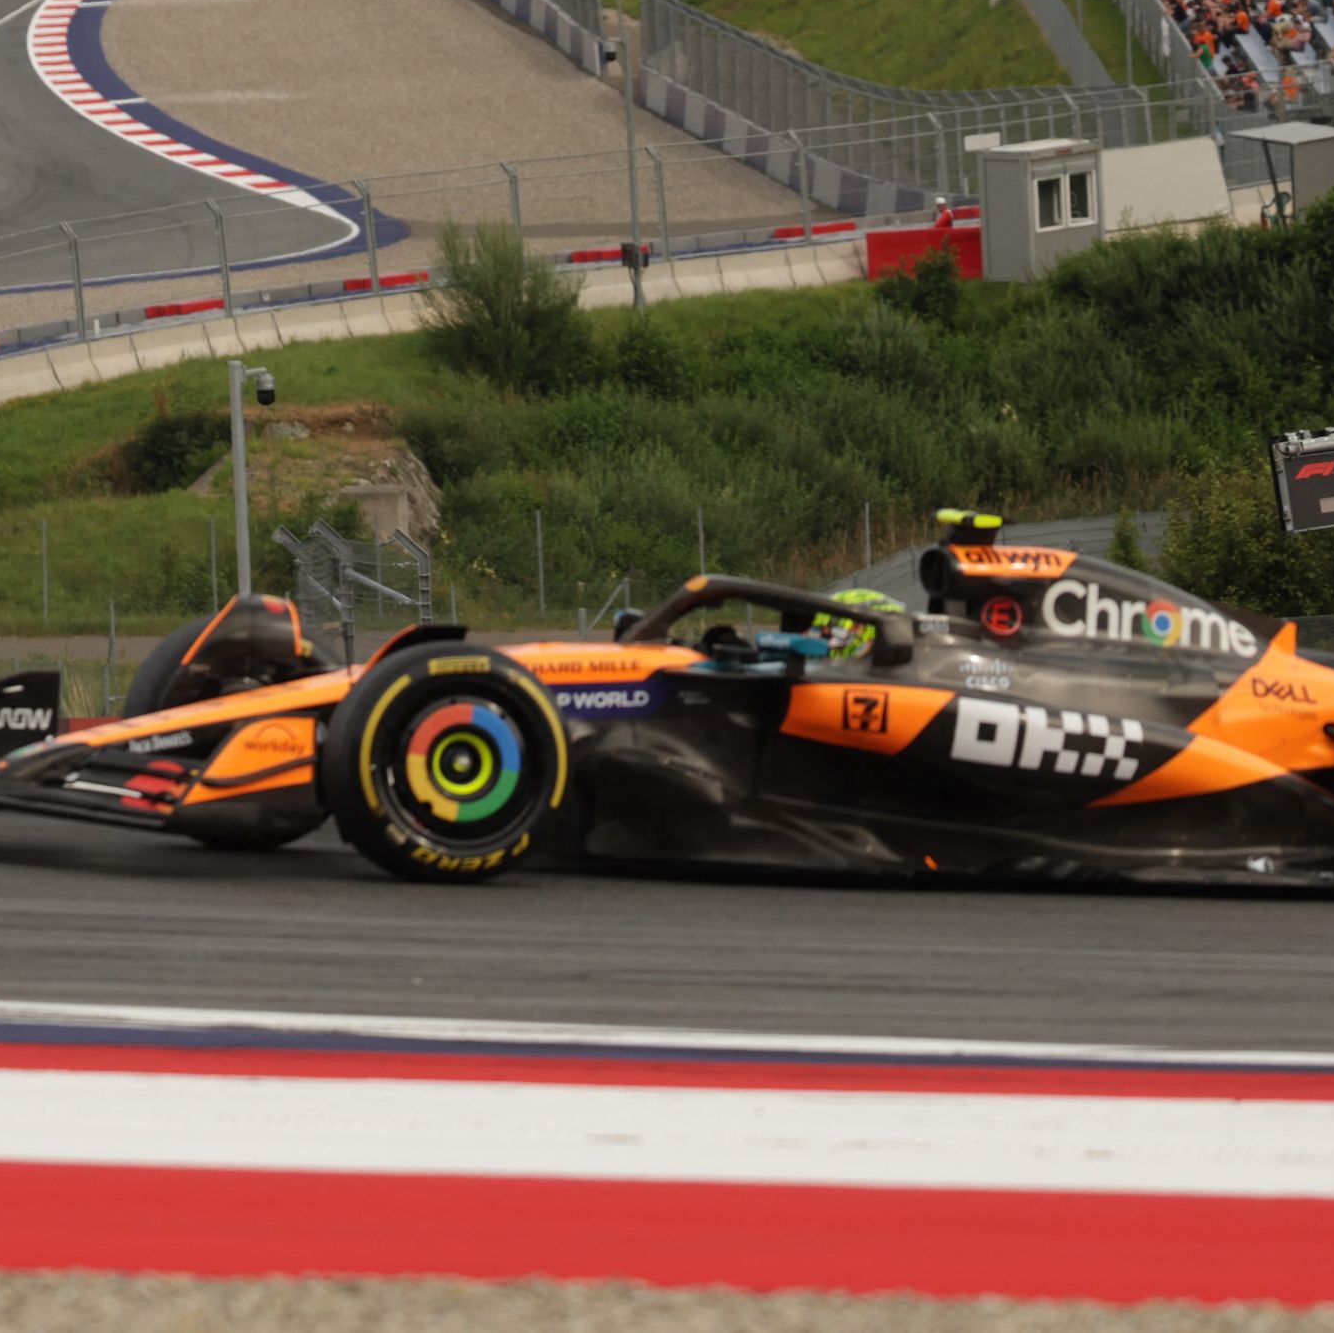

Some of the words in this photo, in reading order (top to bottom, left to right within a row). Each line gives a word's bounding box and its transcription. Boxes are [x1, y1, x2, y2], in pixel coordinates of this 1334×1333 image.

[965, 546, 1062, 572] allwyn
[573, 690, 650, 709] WORLD
[1252, 678, 1317, 704] DELL
[950, 696, 1144, 781] OKX
